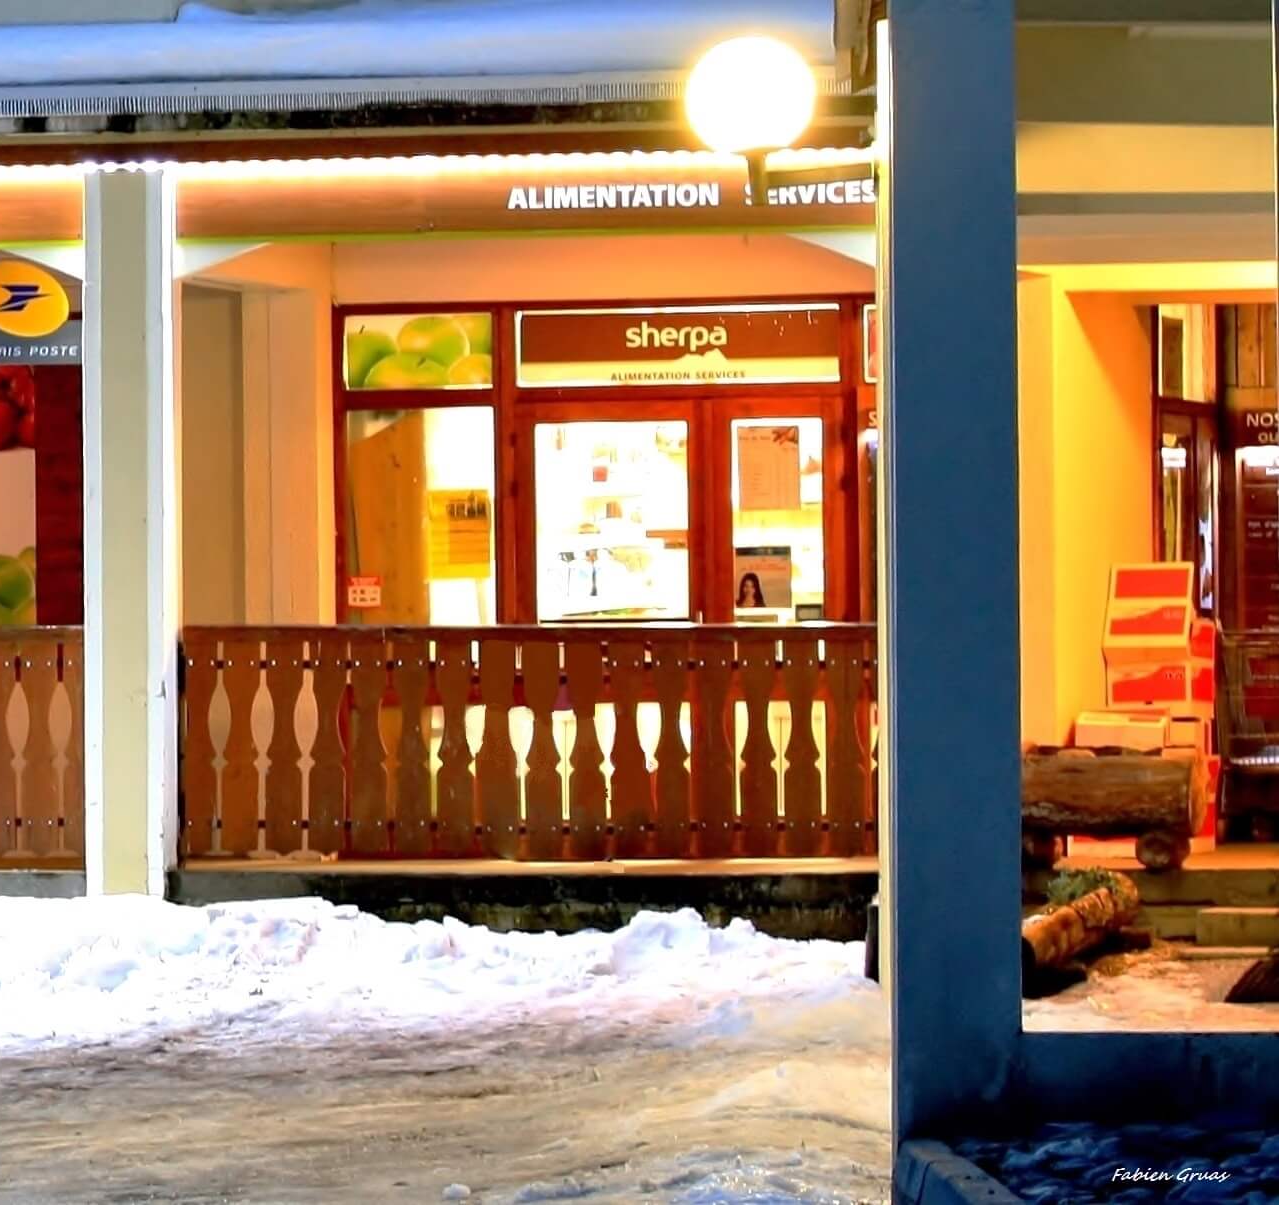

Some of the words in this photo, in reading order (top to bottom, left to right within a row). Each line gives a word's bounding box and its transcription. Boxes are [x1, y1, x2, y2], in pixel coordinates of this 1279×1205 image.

[507, 182, 719, 210] ALIMENTATION
[625, 321, 728, 352] sherpa
[29, 345, 78, 357] POSTE
[610, 371, 690, 382] ALIMENTATION
[694, 370, 747, 380] SERVICES
